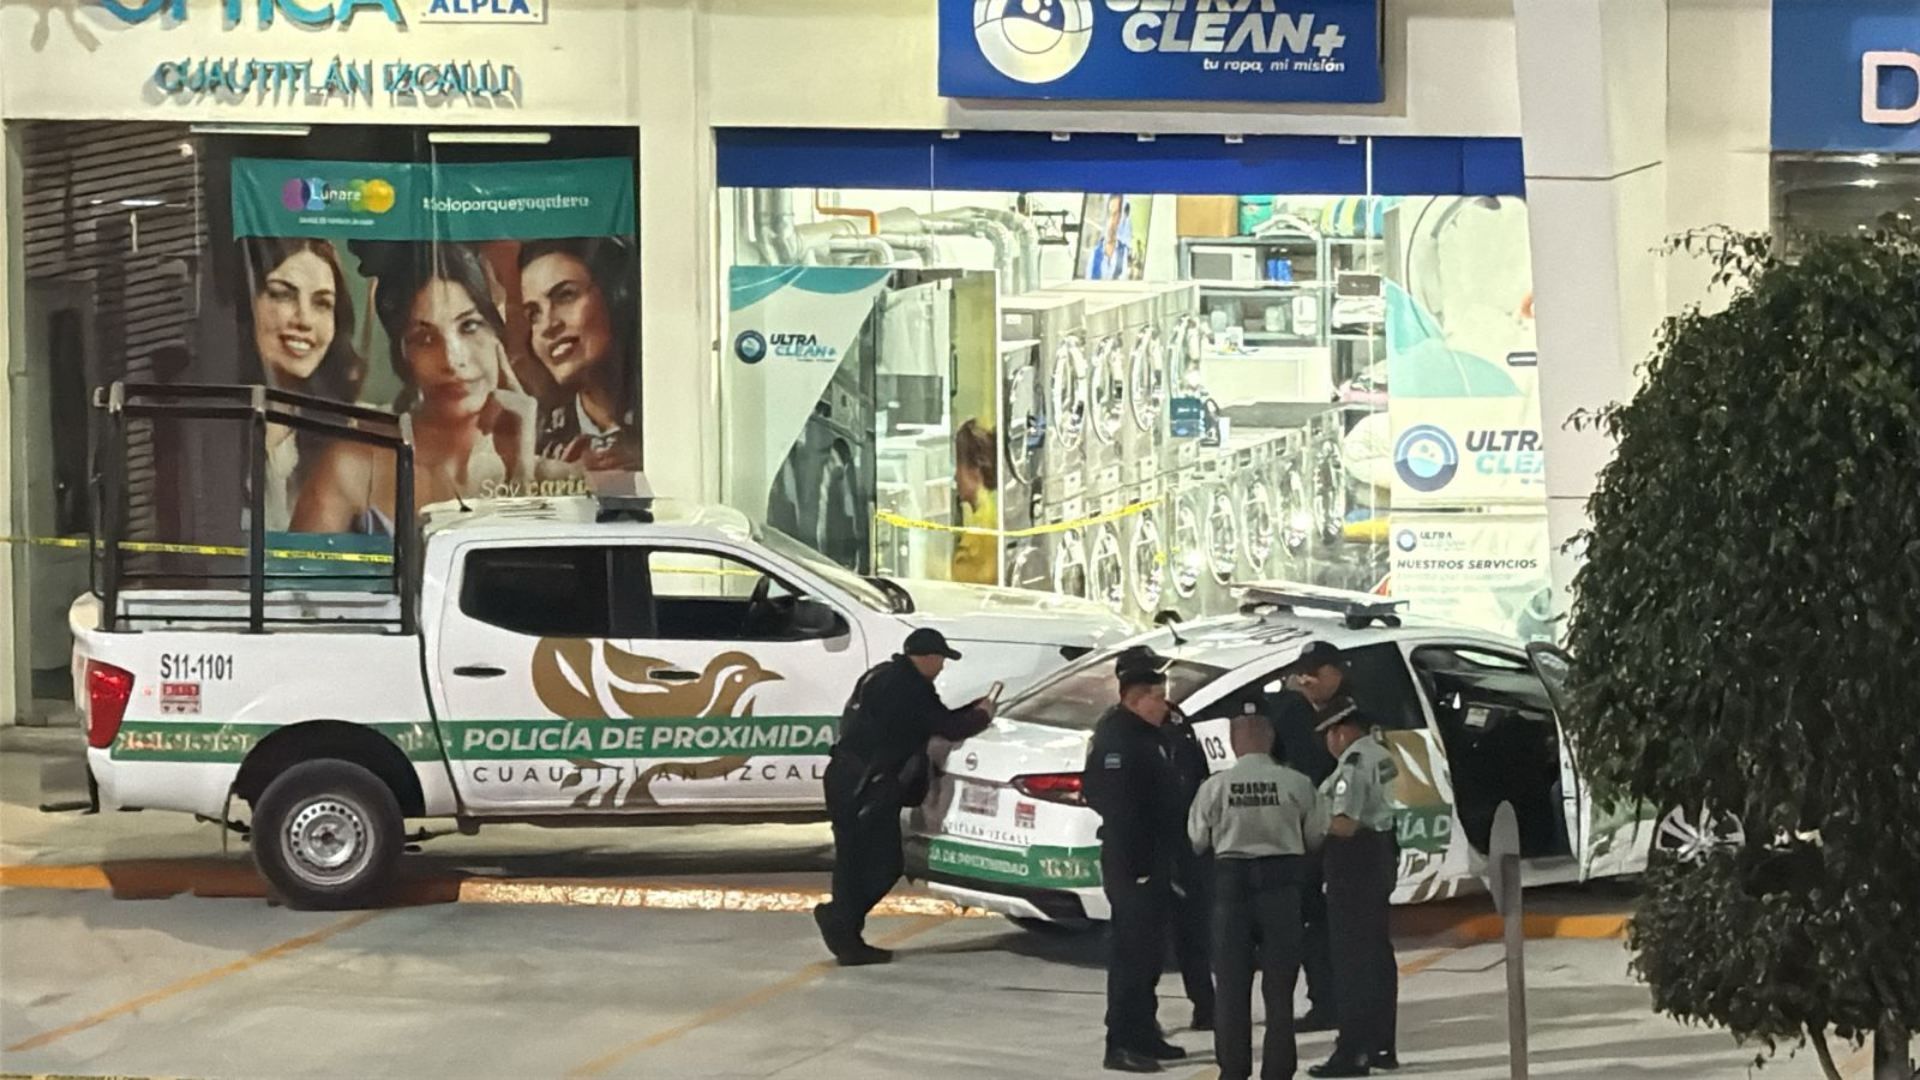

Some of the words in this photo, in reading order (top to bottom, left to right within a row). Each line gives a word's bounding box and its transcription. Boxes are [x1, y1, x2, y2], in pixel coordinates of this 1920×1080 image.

[1203, 58, 1219, 71] tu
[1224, 60, 1263, 73] ropa,
[1270, 58, 1290, 71] mi
[1294, 57, 1345, 72] misión
[770, 333, 817, 346] ULTRA
[1397, 559, 1464, 570] NUESTROS
[1468, 559, 1538, 570] SERVICIOS
[463, 721, 593, 752] POLICÍA
[601, 726, 647, 750] DE
[652, 723, 841, 749] PROXIMIDA
[1205, 736, 1227, 760] 03
